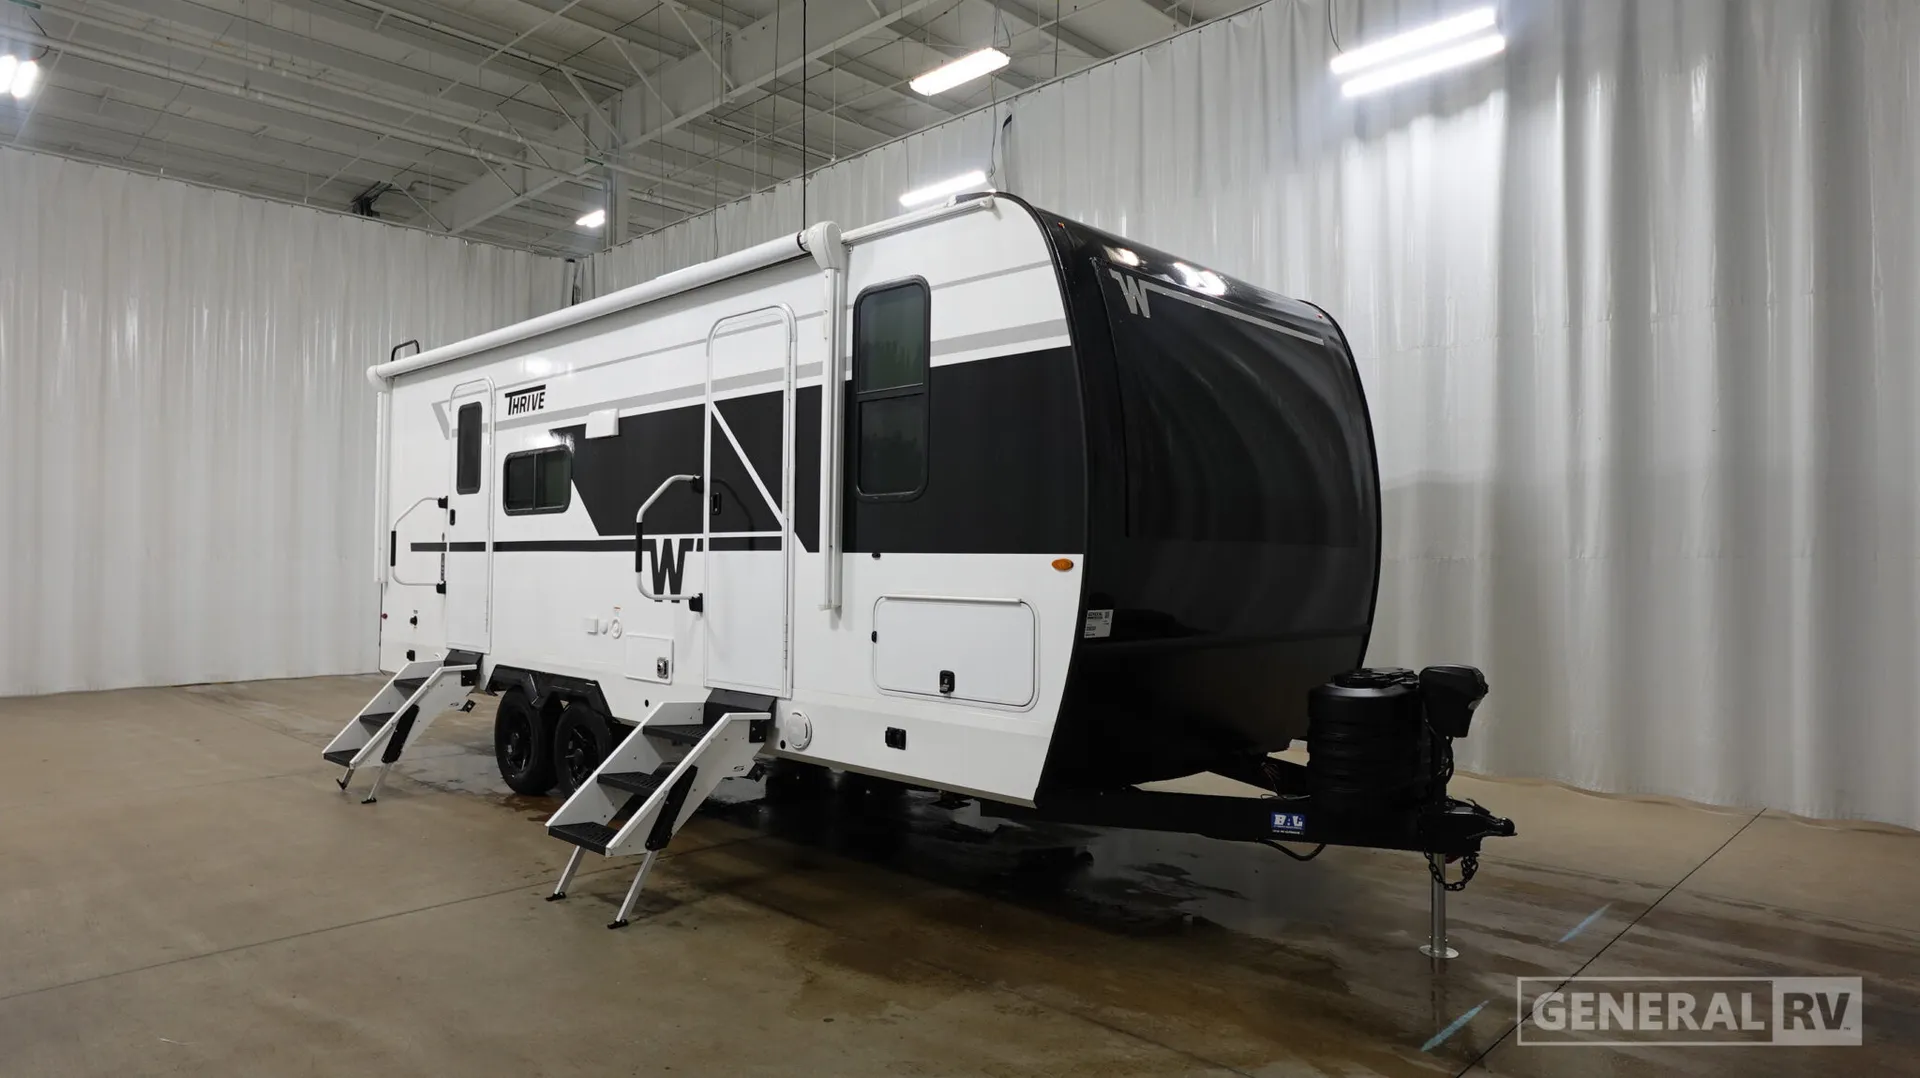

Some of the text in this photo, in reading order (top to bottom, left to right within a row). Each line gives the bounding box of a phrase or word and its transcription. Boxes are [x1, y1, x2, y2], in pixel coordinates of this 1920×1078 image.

[1108, 268, 1151, 319] W
[504, 384, 546, 416] THRIVE
[647, 538, 694, 603] W
